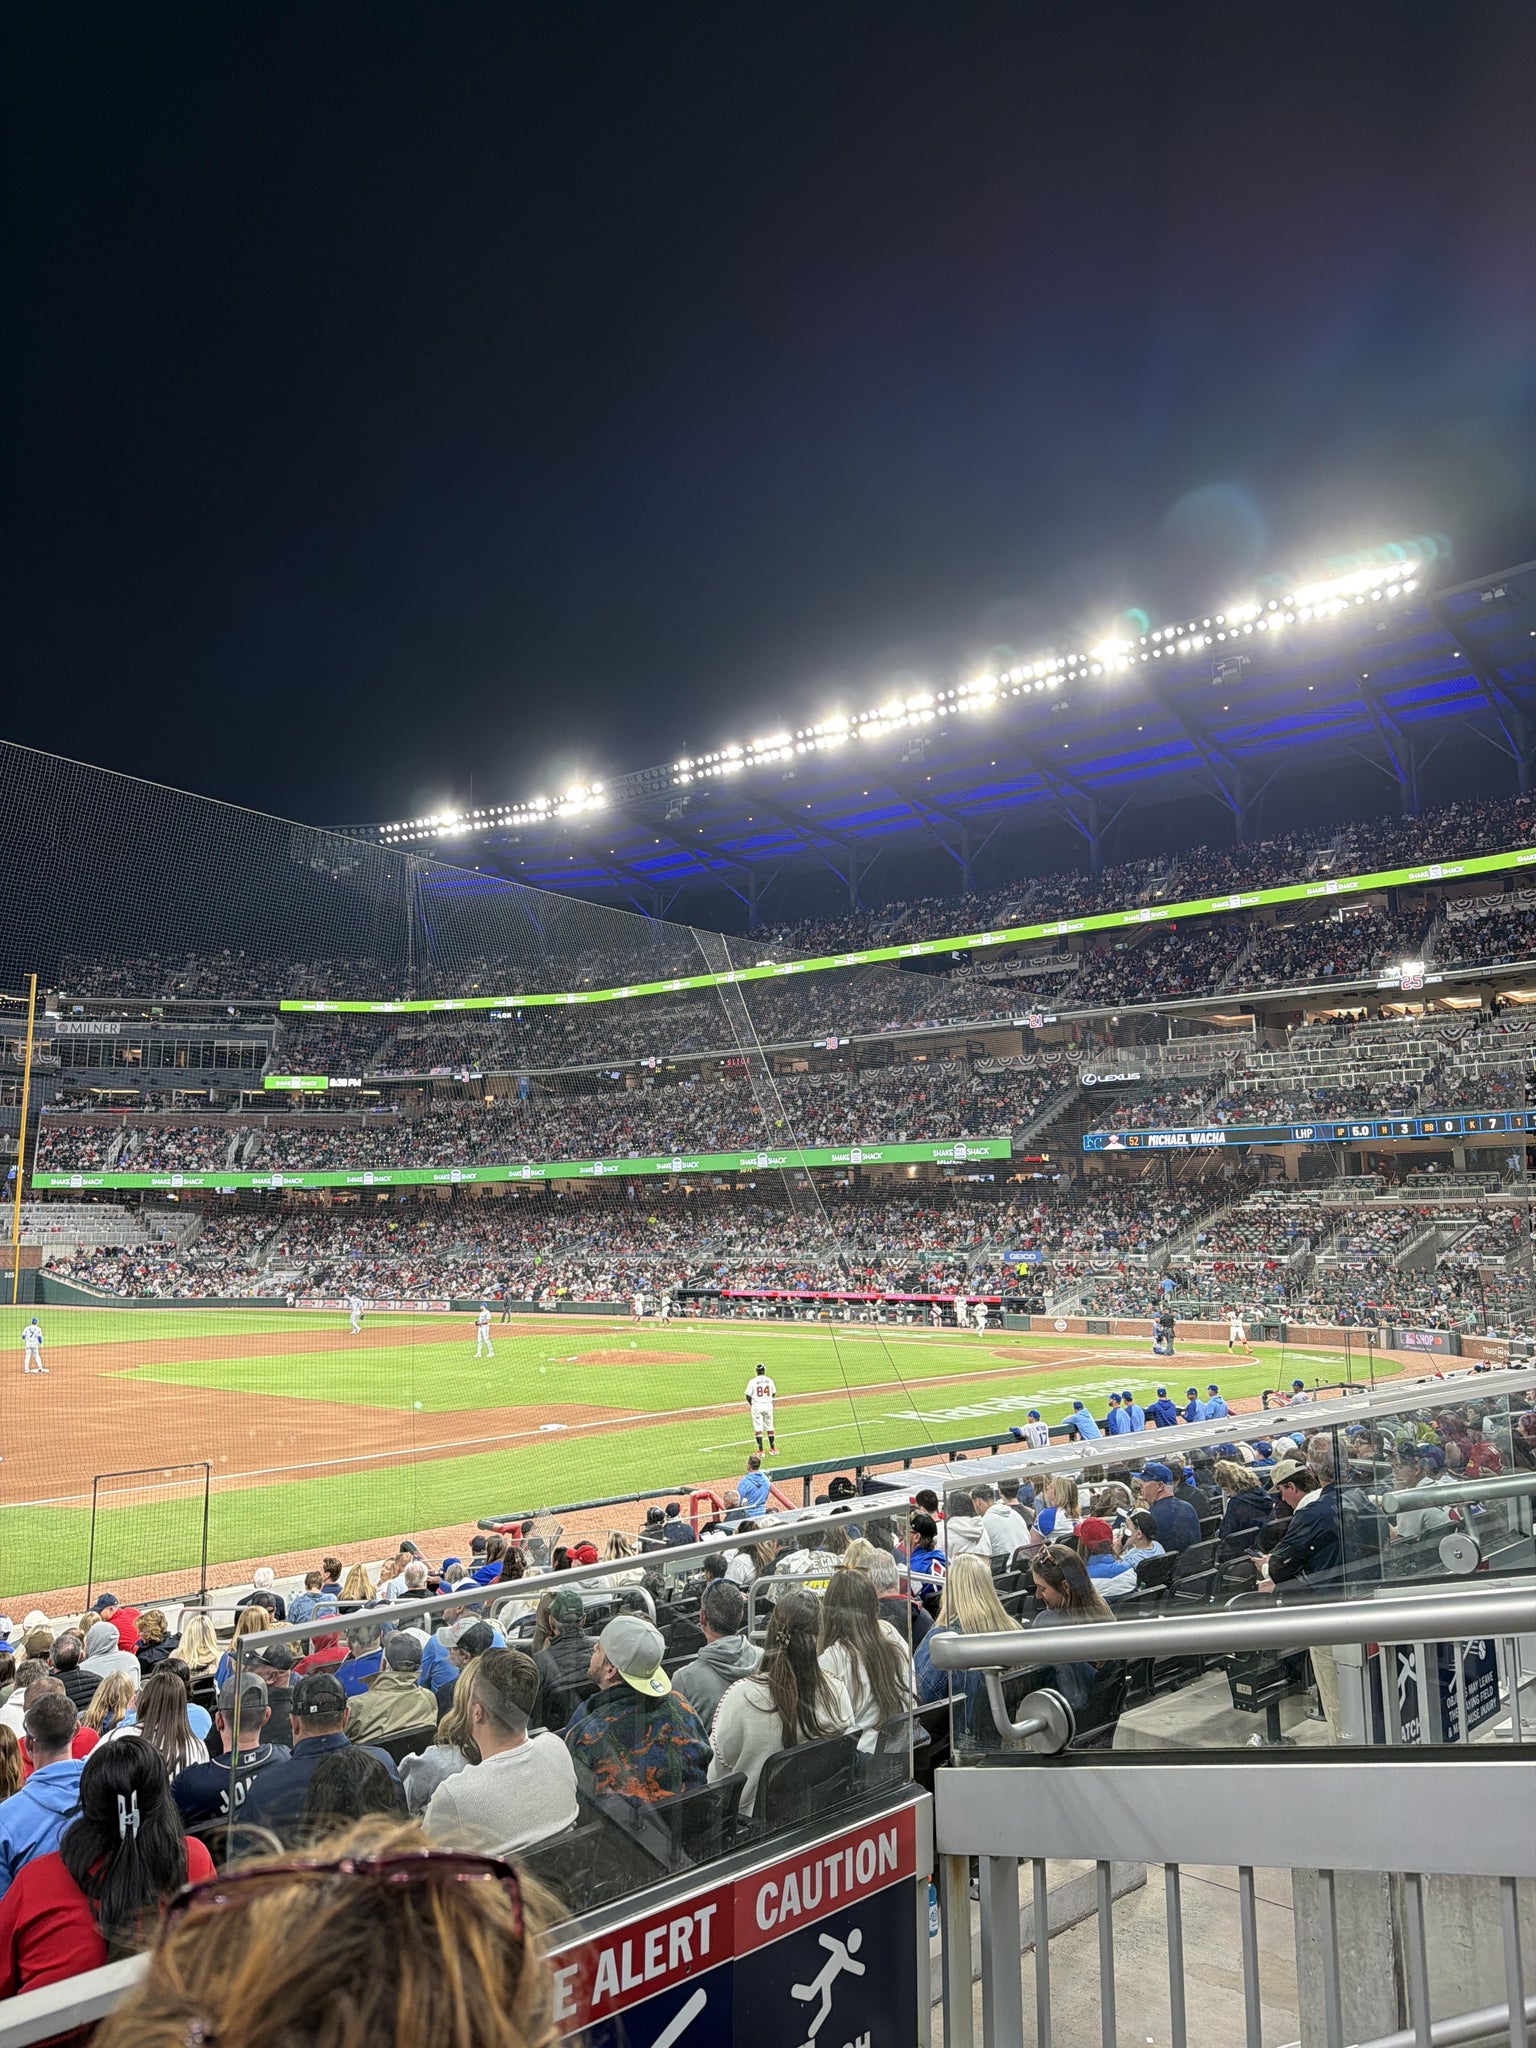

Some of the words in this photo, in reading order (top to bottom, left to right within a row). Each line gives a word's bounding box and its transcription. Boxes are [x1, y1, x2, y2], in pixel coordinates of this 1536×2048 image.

[1442, 866, 1465, 875] SHACK
[1306, 887, 1326, 895] SHAKE
[1338, 882, 1359, 890] SHACK
[1240, 897, 1260, 905] SHACK
[1401, 975, 1423, 991] 25
[1030, 1014, 1043, 1028] 21
[70, 1024, 118, 1033] MILNER
[826, 1036, 838, 1050] 10
[1098, 1073, 1140, 1081] LEXUS
[1129, 1137, 1139, 1146] 52
[1148, 1133, 1189, 1146] MICHAEL
[1191, 1132, 1226, 1144] WACHA
[1295, 1128, 1313, 1139] LHP
[1352, 1126, 1369, 1137] 5.0
[1382, 1126, 1387, 1134] H
[1401, 1124, 1408, 1134] 3
[1425, 1123, 1434, 1132] BB
[1445, 1121, 1453, 1131] 0
[1470, 1121, 1476, 1129] K
[1489, 1118, 1496, 1129] 7
[831, 1153, 850, 1162] SHAKE
[862, 1152, 883, 1160] SHACK
[933, 1149, 953, 1157] SHAKE
[967, 1147, 990, 1155] SHACK
[682, 1161, 699, 1169] SHACK
[768, 1156, 787, 1164] SHACK
[1416, 1334, 1434, 1345] SHOP
[757, 1385, 770, 1397] 84
[1040, 1432, 1047, 1445] 17
[1468, 1680, 1479, 1695] MAY
[1479, 1671, 1494, 1688] LEAVE
[1480, 1686, 1494, 1702] FIELD
[1480, 1697, 1497, 1716] INJURY
[1401, 1717, 1421, 1742] ATCH
[755, 1826, 898, 1932] CAUTION
[591, 1903, 717, 2005] ALERT
